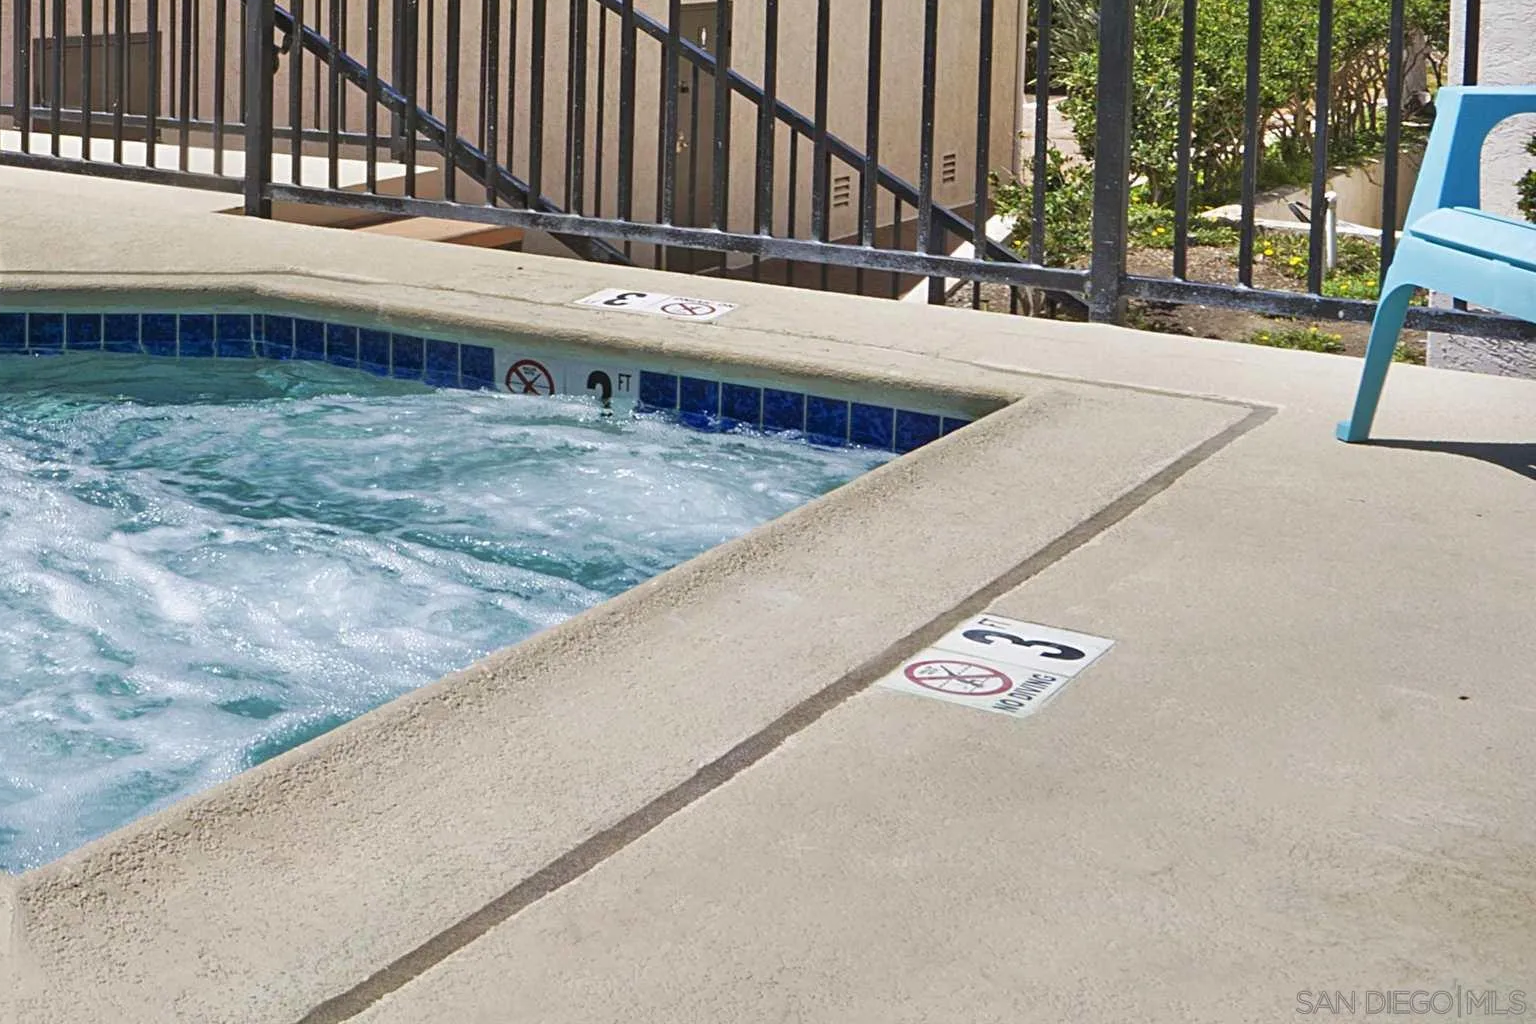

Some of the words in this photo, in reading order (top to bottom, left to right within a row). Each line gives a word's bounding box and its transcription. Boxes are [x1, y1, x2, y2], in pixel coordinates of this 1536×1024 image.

[603, 292, 647, 306] 3
[618, 372, 632, 392] FT
[977, 617, 1012, 630] FT
[962, 629, 1086, 662] 3
[1007, 673, 1057, 701] DIVING
[991, 698, 1025, 714] NO
